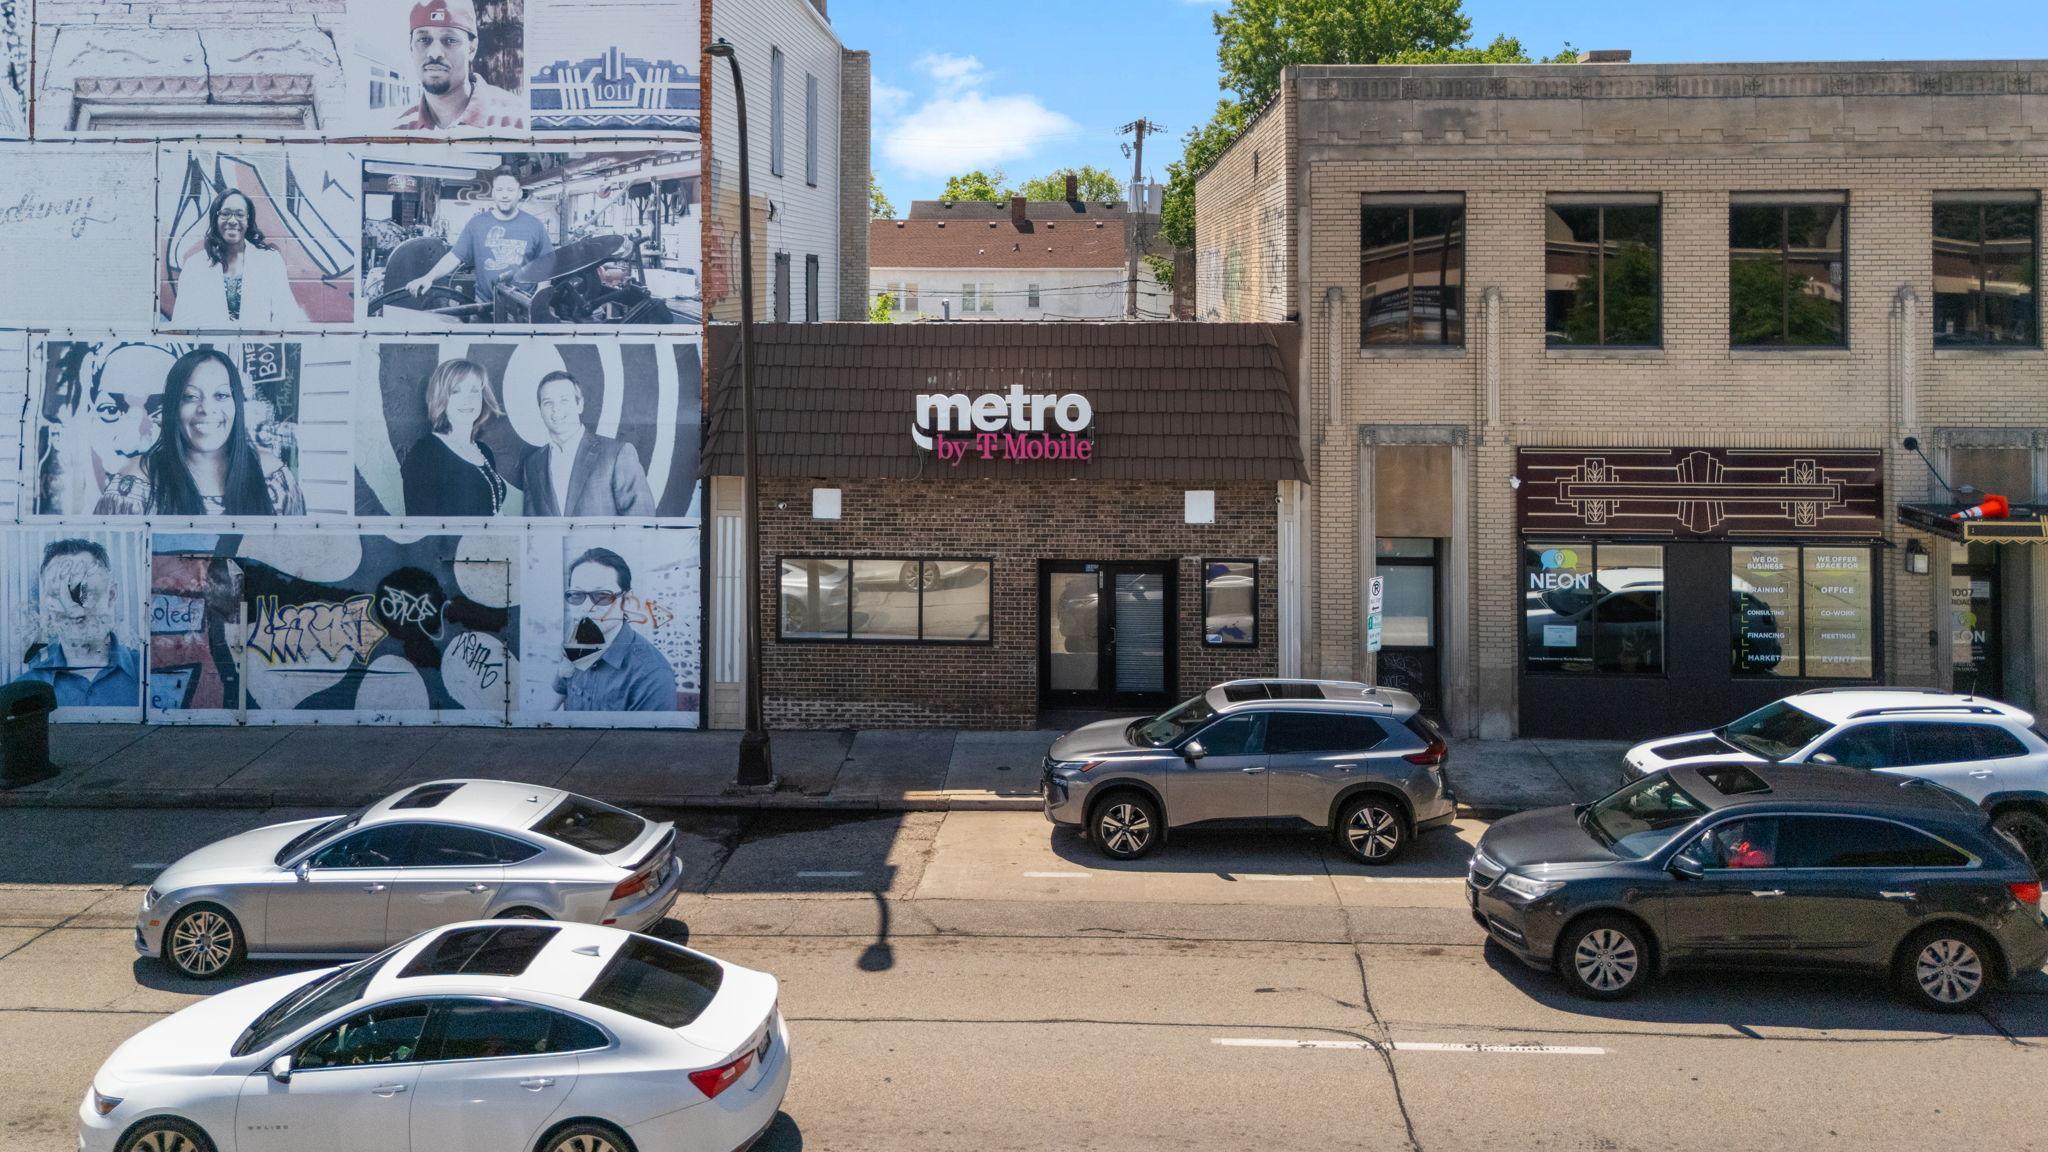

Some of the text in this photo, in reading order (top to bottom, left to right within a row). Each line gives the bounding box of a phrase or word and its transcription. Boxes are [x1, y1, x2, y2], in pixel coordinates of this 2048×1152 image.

[598, 84, 630, 100] 1011
[244, 343, 256, 375] THE
[915, 384, 1092, 432] metro
[937, 433, 968, 466] by
[1530, 572, 1589, 589] NEON
[1820, 586, 1854, 594] OFFICE
[1952, 630, 1986, 643] EON
